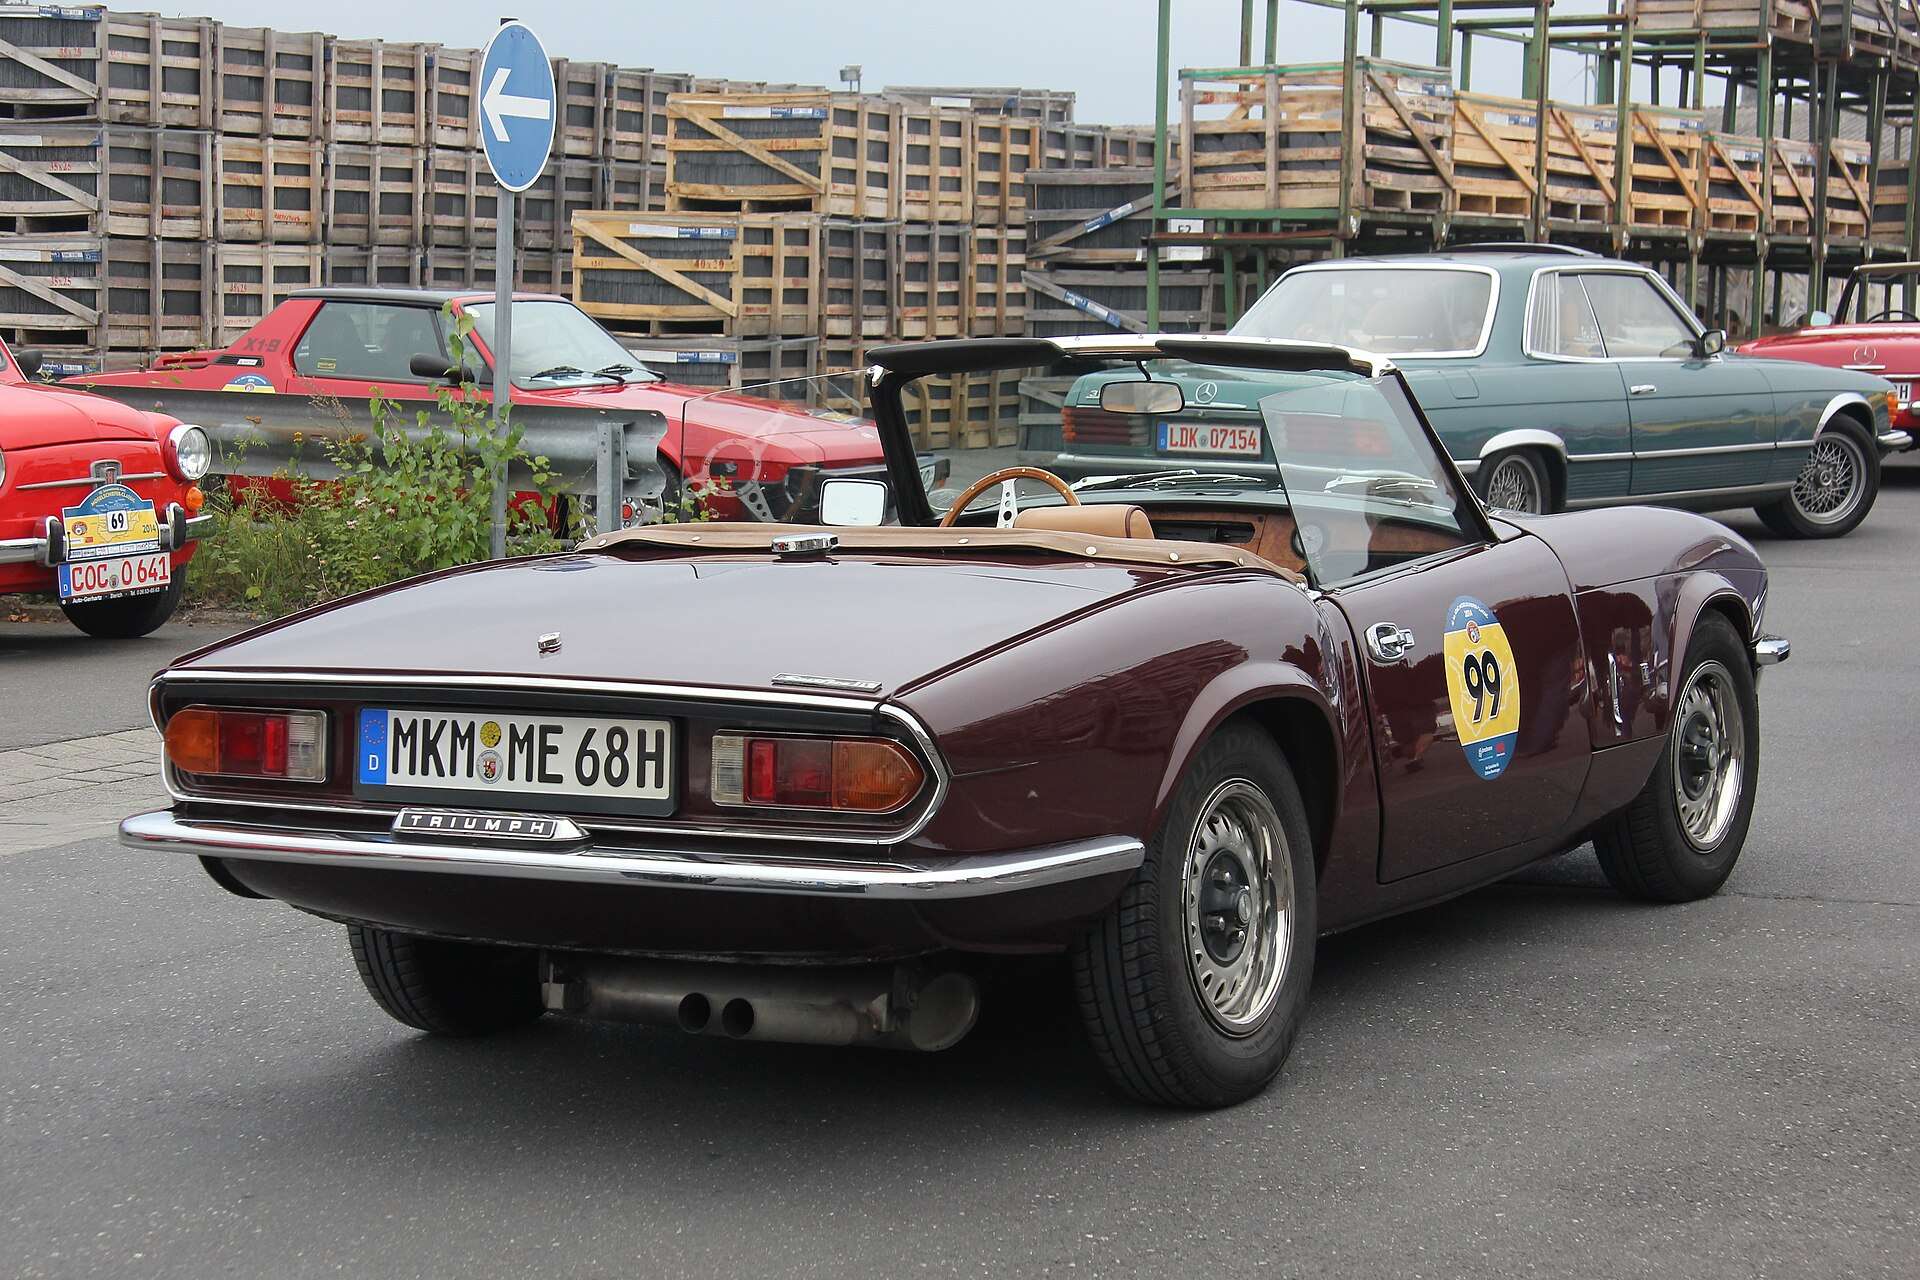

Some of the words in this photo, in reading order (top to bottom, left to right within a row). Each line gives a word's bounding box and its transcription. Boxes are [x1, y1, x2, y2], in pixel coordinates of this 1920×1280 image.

[1169, 427, 1198, 448] LDK
[1210, 428, 1257, 449] 07154
[111, 513, 124, 529] 69
[142, 524, 156, 534] 2014
[72, 564, 108, 591] COC
[137, 556, 169, 583] 641
[1463, 649, 1502, 722] 99
[368, 754, 378, 771] D
[391, 717, 476, 779] MKM
[507, 722, 564, 784] ME
[575, 725, 665, 789] 68H
[411, 814, 545, 834] TRIUMPH
